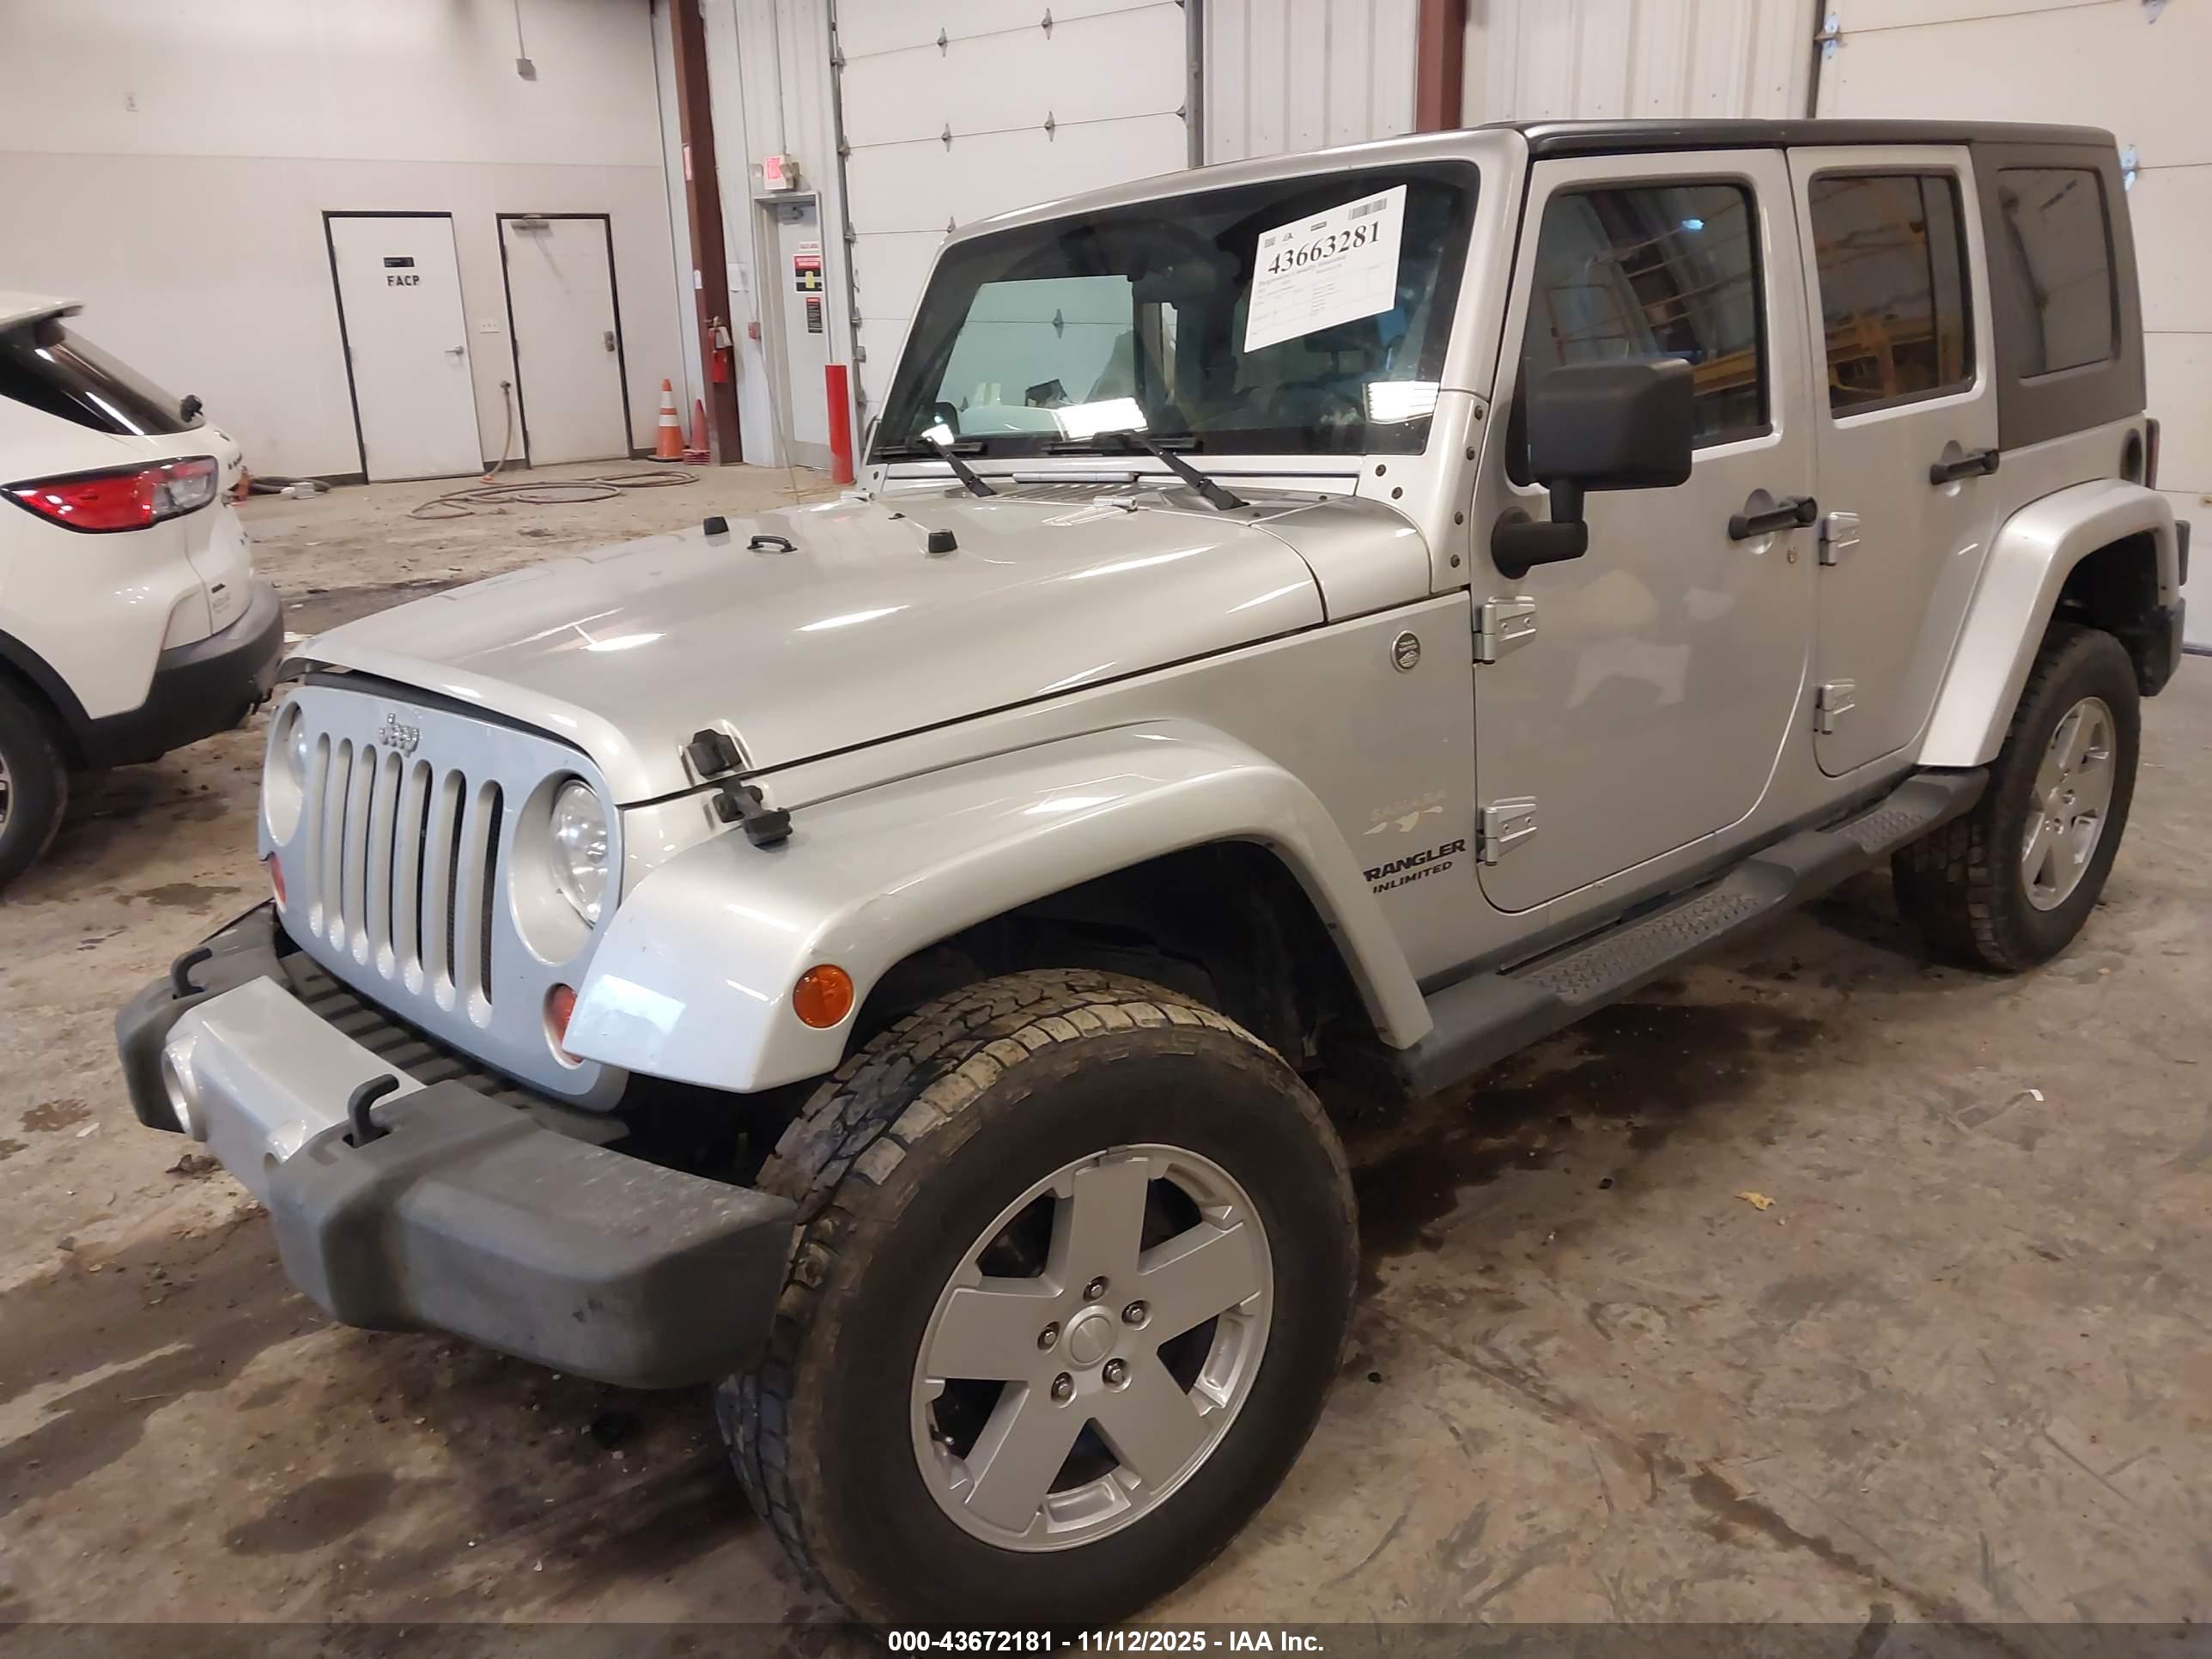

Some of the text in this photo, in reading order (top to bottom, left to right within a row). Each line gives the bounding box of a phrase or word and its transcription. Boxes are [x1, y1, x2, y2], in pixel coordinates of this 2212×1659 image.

[1267, 221, 1380, 275] 43663281
[386, 275, 420, 287] FACP
[1363, 839, 1467, 882] RANGLER
